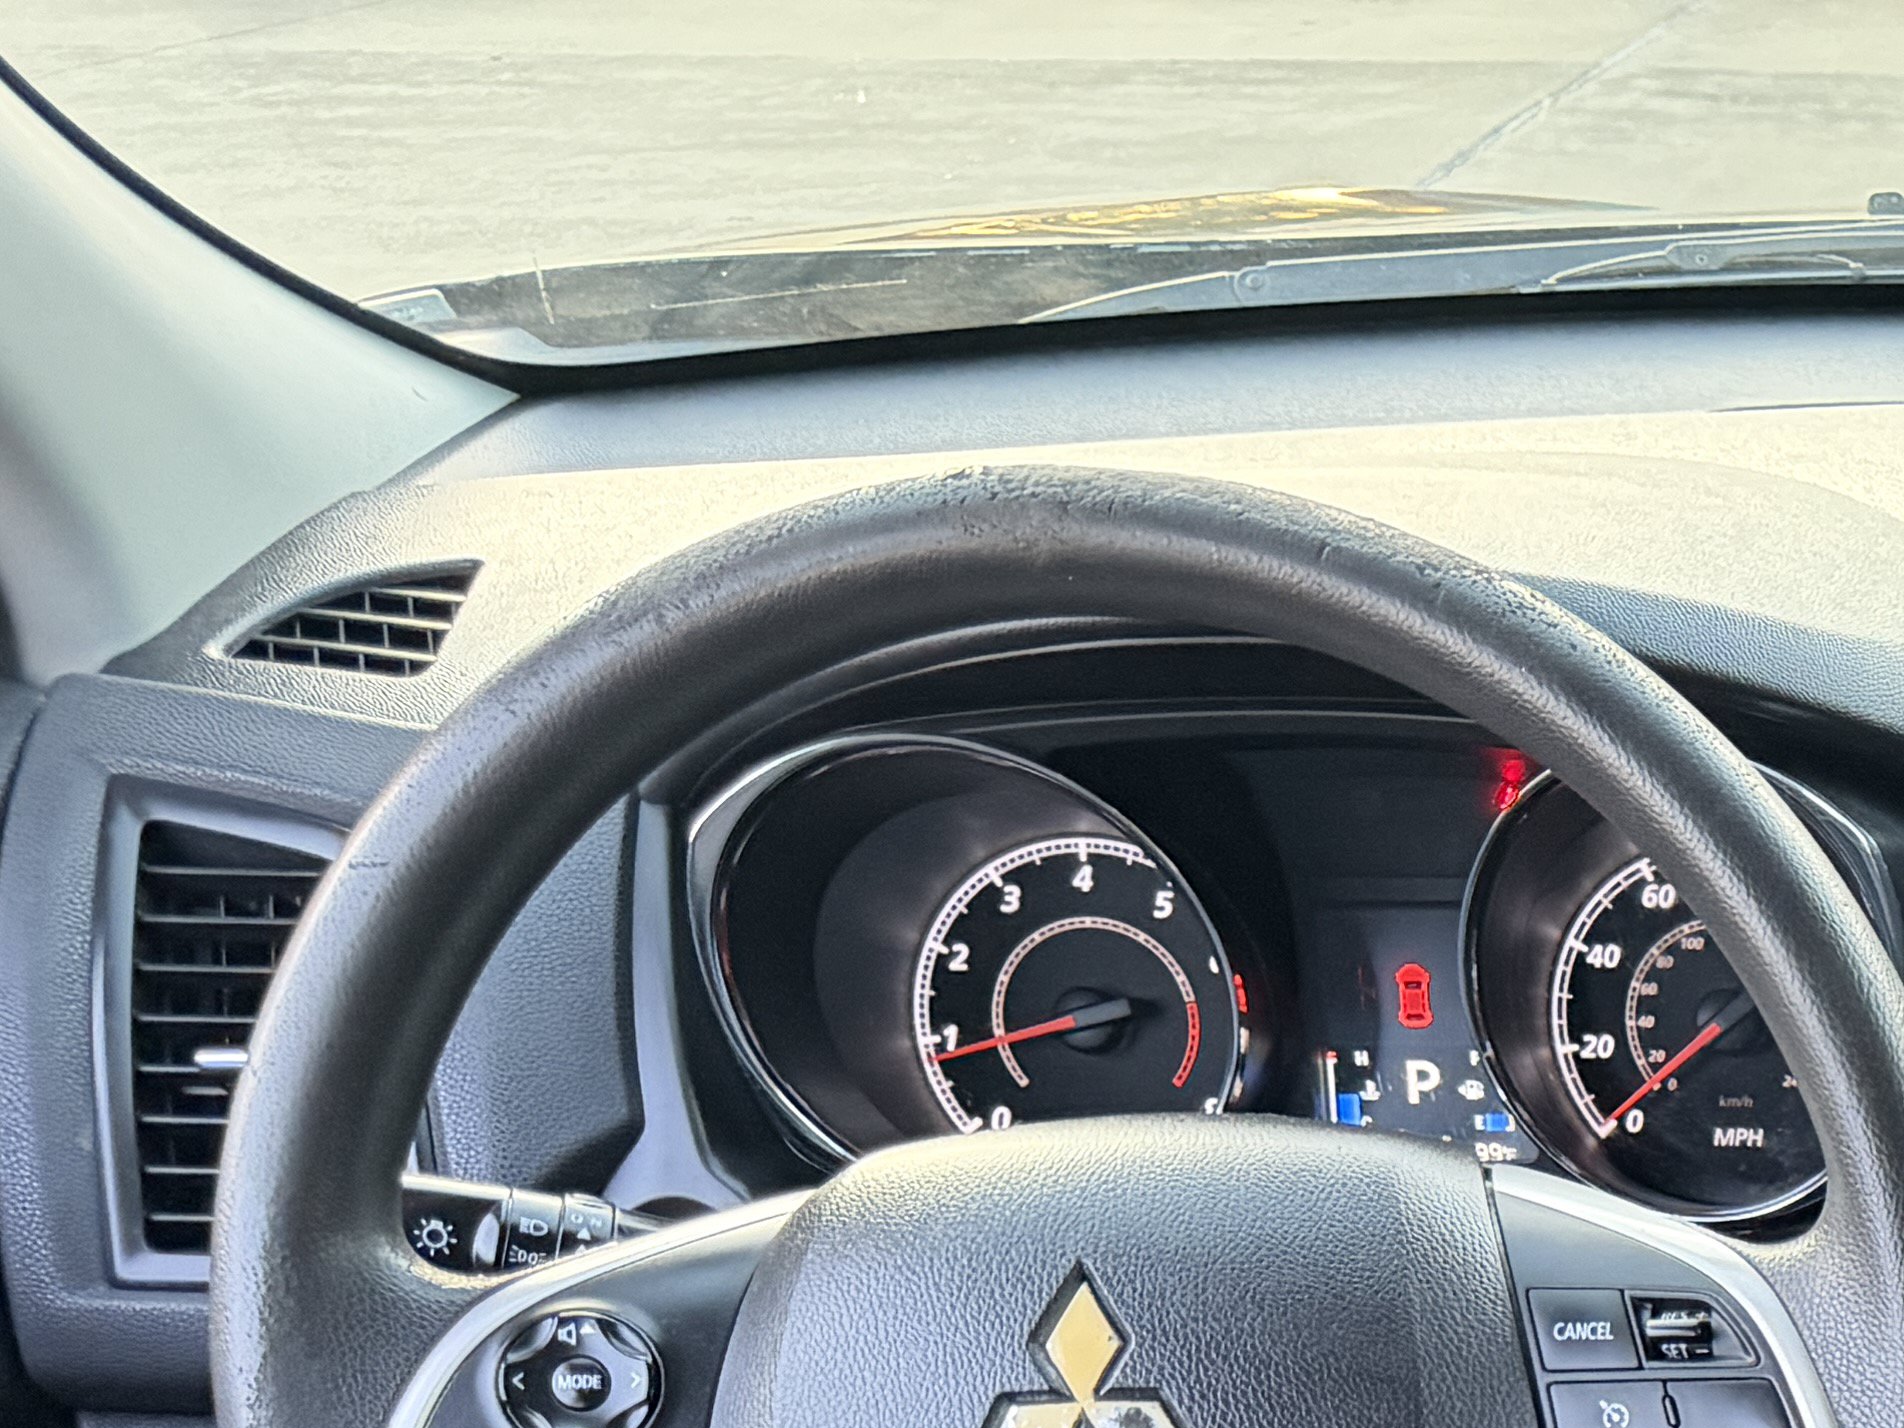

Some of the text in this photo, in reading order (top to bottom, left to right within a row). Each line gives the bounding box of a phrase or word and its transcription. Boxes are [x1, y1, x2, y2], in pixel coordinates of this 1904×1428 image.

[1072, 864, 1094, 892] 4
[1000, 885, 1022, 913] 3
[1153, 890, 1175, 919] 5
[1641, 883, 1676, 909] 60
[1681, 937, 1704, 951] 100
[948, 943, 970, 971] 2
[1586, 944, 1621, 969] 40
[1638, 1015, 1656, 1028] 40
[942, 1024, 959, 1051] 1
[1579, 1034, 1615, 1059] 20
[1354, 1050, 1370, 1067] H
[1648, 1050, 1666, 1063] 20
[1406, 1059, 1441, 1105] P
[1667, 1077, 1678, 1091] 0
[1719, 1094, 1754, 1107] km/h
[991, 1105, 1012, 1130] 0
[1625, 1109, 1644, 1133] 0
[1713, 1128, 1764, 1147] MPH
[1553, 1321, 1614, 1340] CANCEL
[1661, 1343, 1688, 1359] SET
[557, 1373, 604, 1390] MODE
